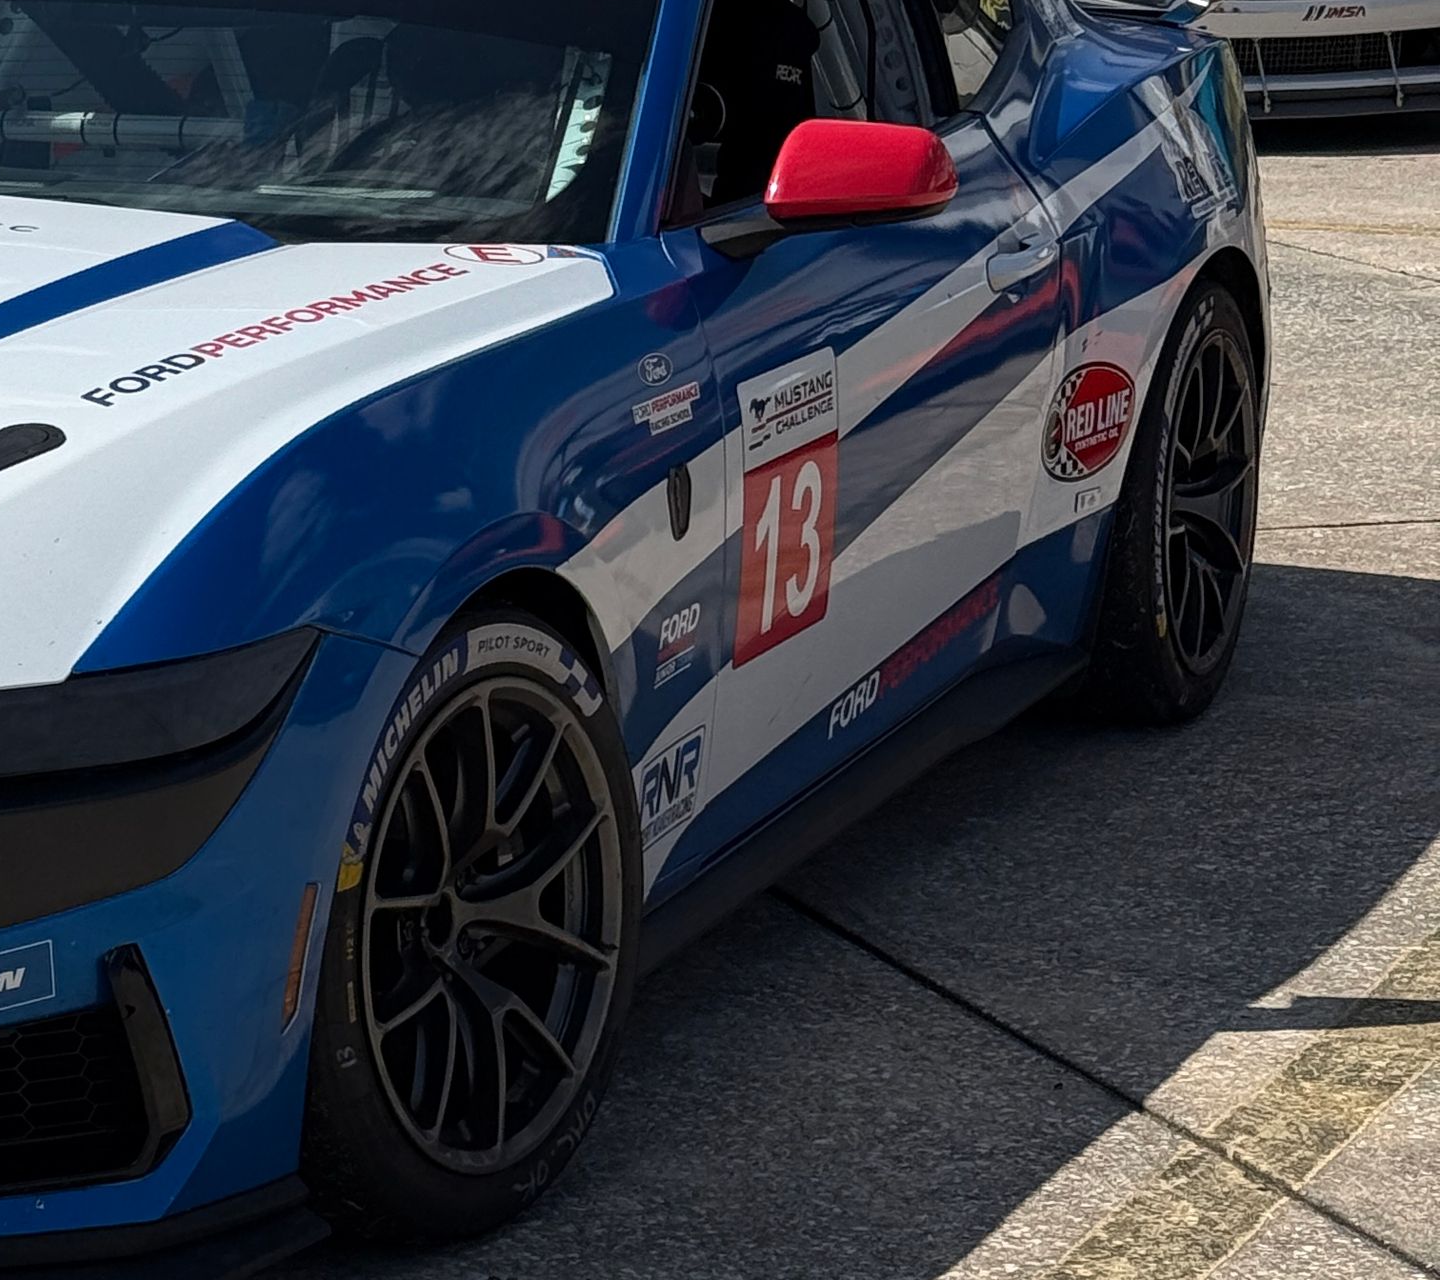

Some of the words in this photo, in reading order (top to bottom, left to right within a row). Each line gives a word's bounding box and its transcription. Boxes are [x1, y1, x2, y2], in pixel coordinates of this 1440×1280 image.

[1324, 5, 1366, 19] IMSA
[643, 357, 668, 382] Ford
[773, 371, 833, 414] MUSTANG
[775, 396, 834, 436] CHALLENGE
[1066, 401, 1095, 444] RED
[1096, 387, 1130, 432] LINE
[755, 460, 822, 637] 13
[477, 636, 510, 654] PILOT
[511, 637, 550, 658] SPORT
[658, 602, 701, 651] FORD
[827, 669, 880, 740] FORD
[362, 648, 459, 814] MICHELIN
[641, 735, 702, 819] RNR
